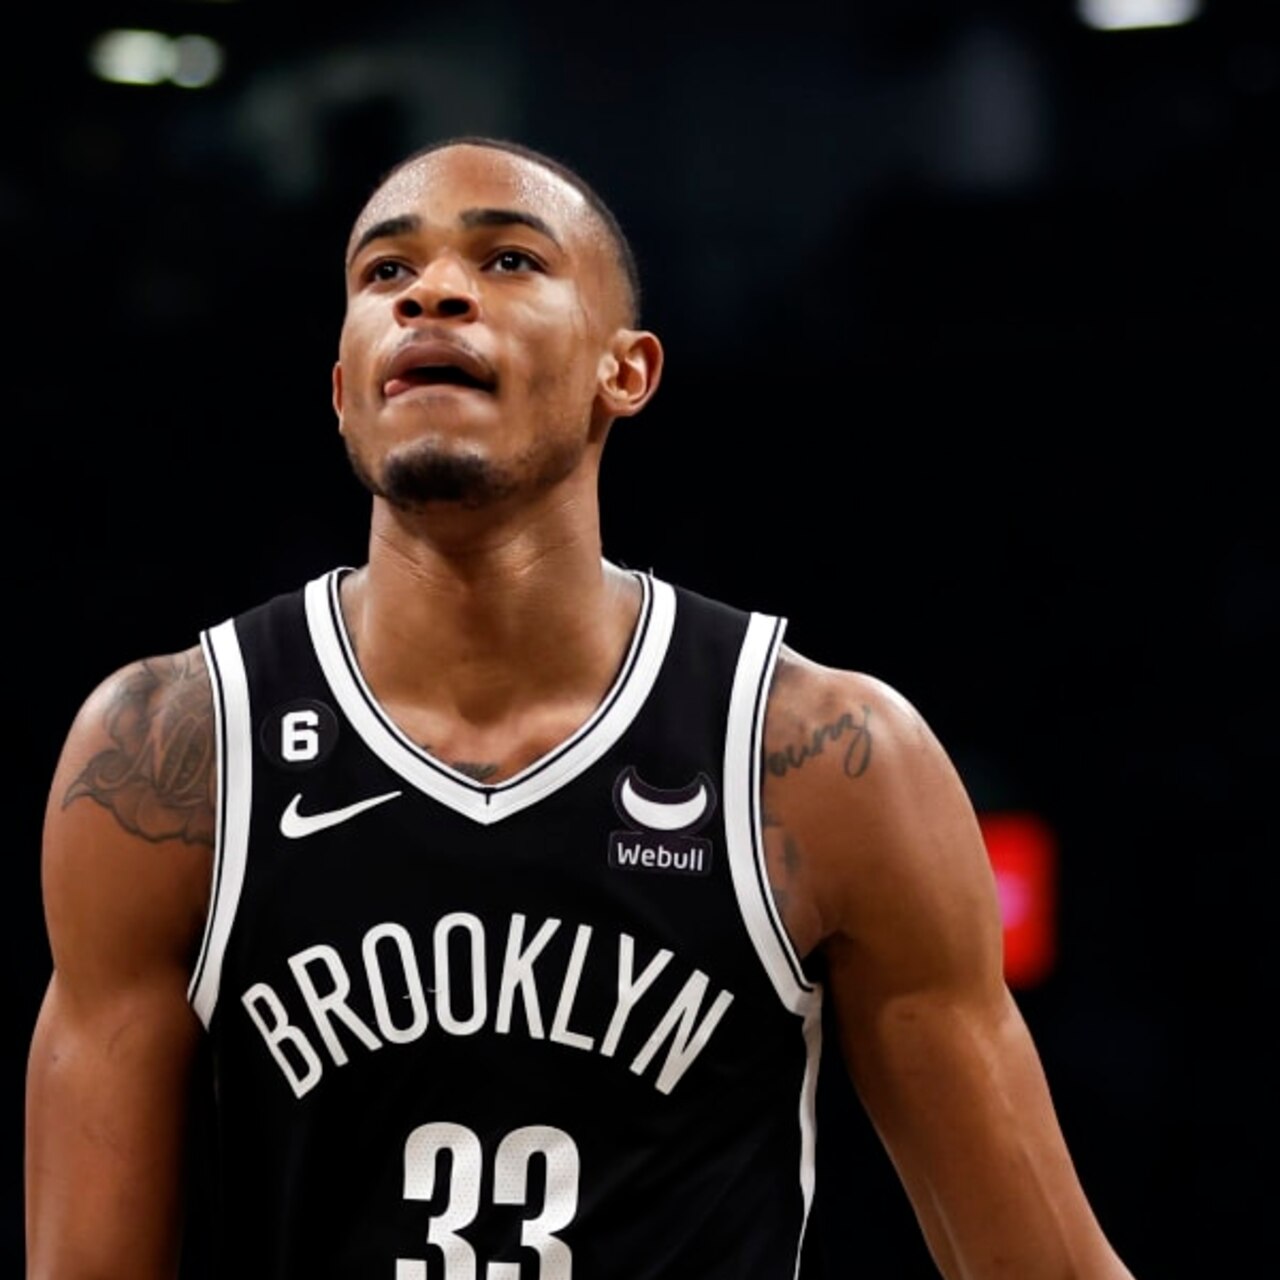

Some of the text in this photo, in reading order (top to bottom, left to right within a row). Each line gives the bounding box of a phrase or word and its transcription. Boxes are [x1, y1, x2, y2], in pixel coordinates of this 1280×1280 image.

[281, 709, 319, 762] 6
[617, 842, 704, 871] Webull
[241, 912, 734, 1099] BROOKLYN
